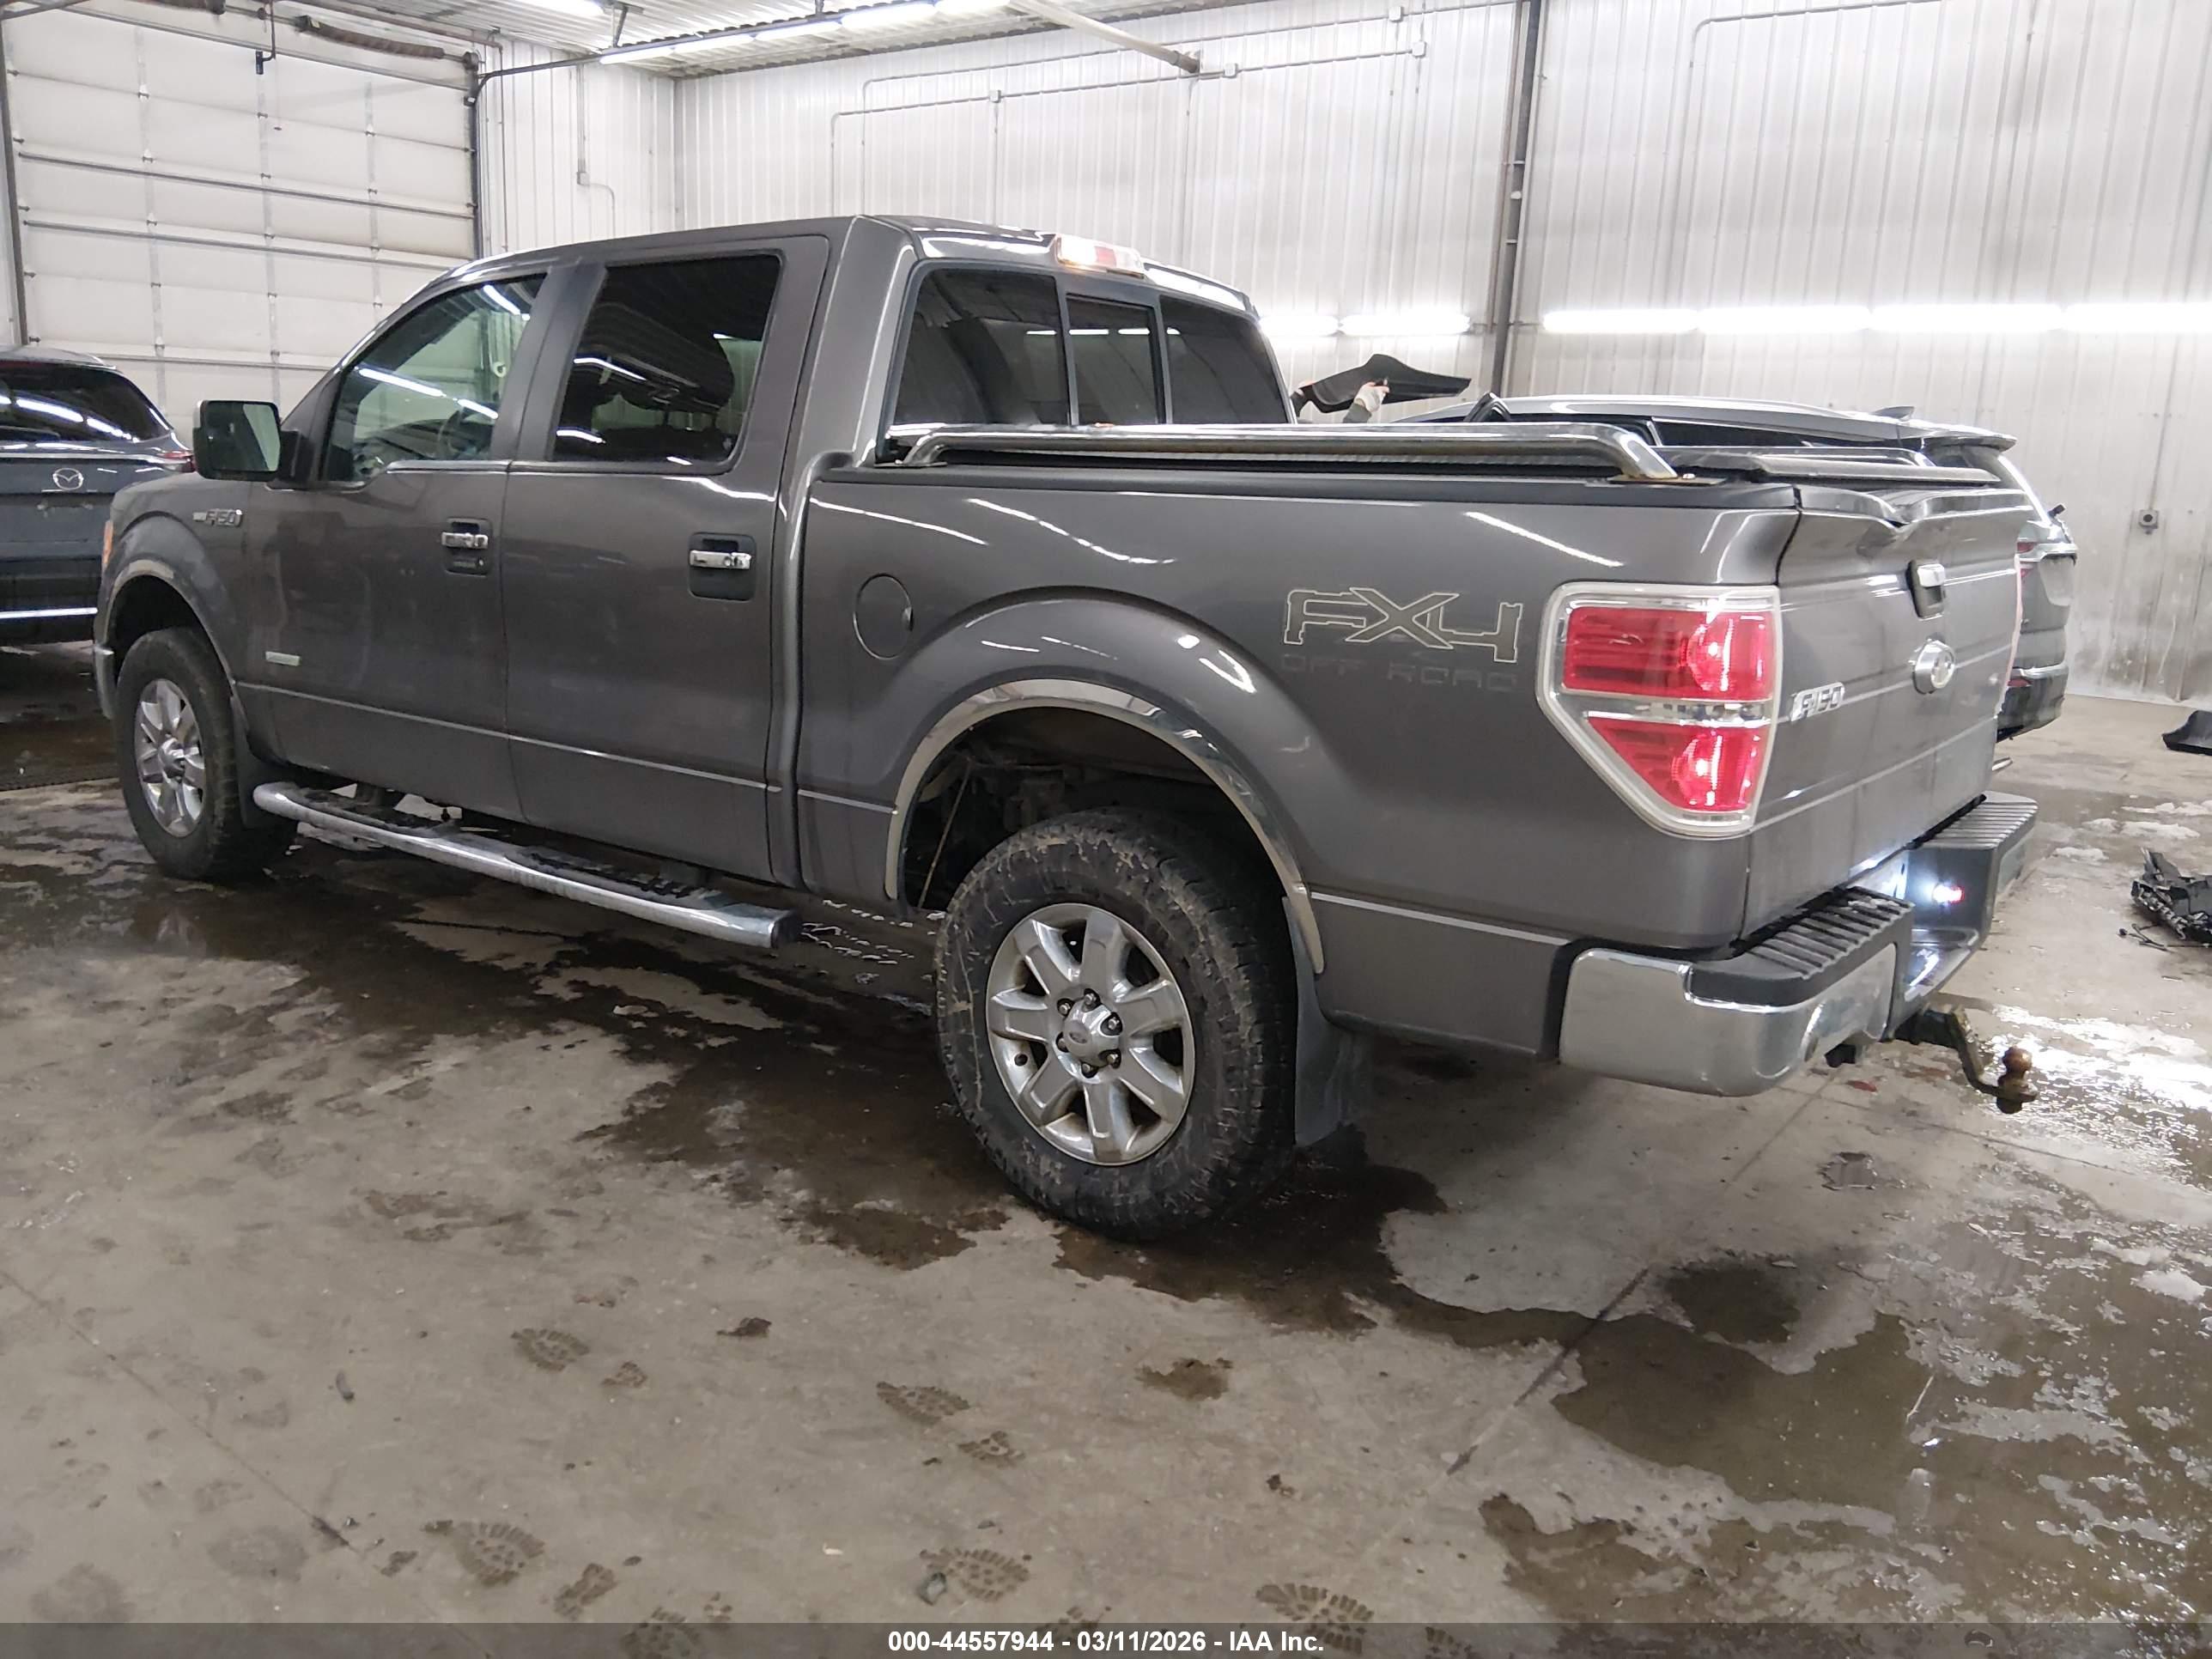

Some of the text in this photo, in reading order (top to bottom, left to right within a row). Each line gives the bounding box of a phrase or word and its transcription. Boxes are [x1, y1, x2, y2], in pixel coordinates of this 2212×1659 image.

[1284, 587, 1523, 663] FX4
[1280, 653, 1517, 692] OFF ROAD
